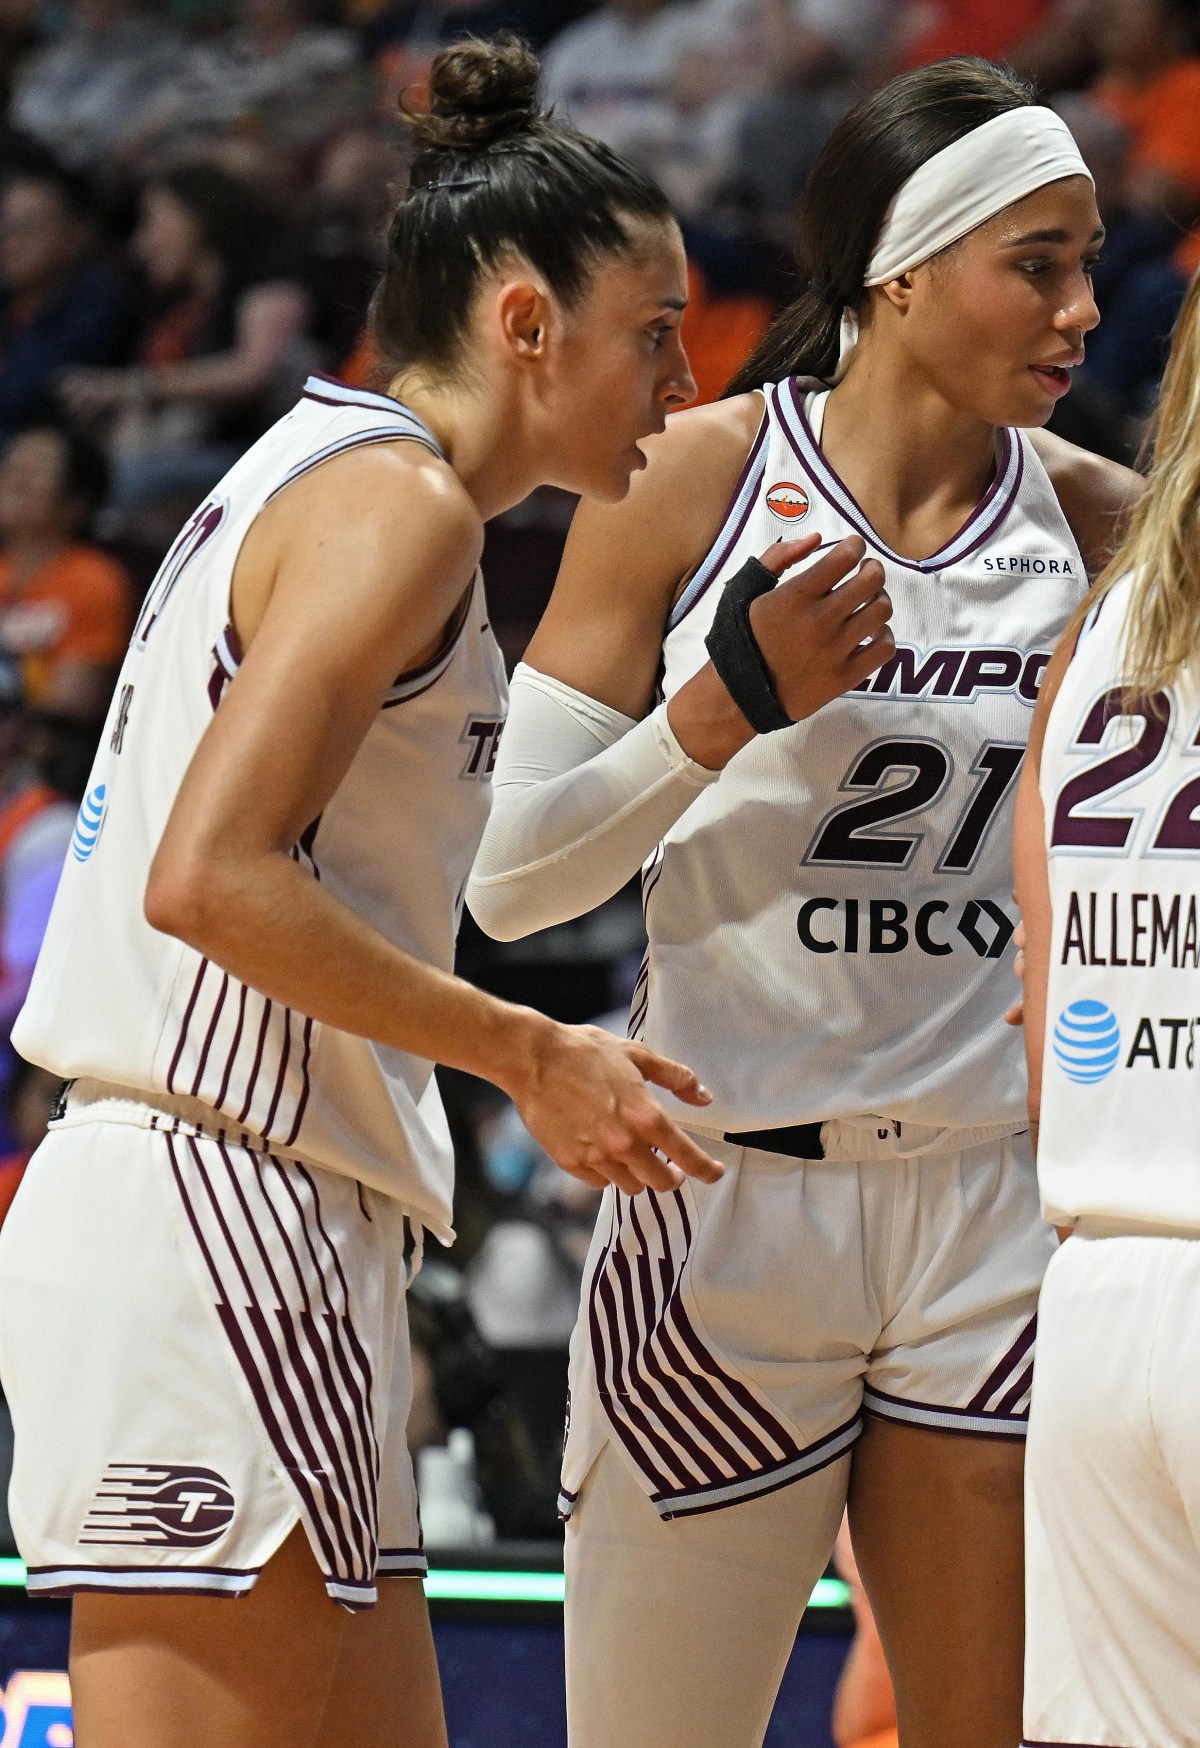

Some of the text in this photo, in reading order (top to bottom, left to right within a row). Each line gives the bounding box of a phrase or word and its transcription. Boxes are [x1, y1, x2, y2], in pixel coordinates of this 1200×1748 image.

[984, 557, 1072, 574] SEPHORA
[800, 735, 1026, 875] 21
[797, 897, 954, 956] CIBC
